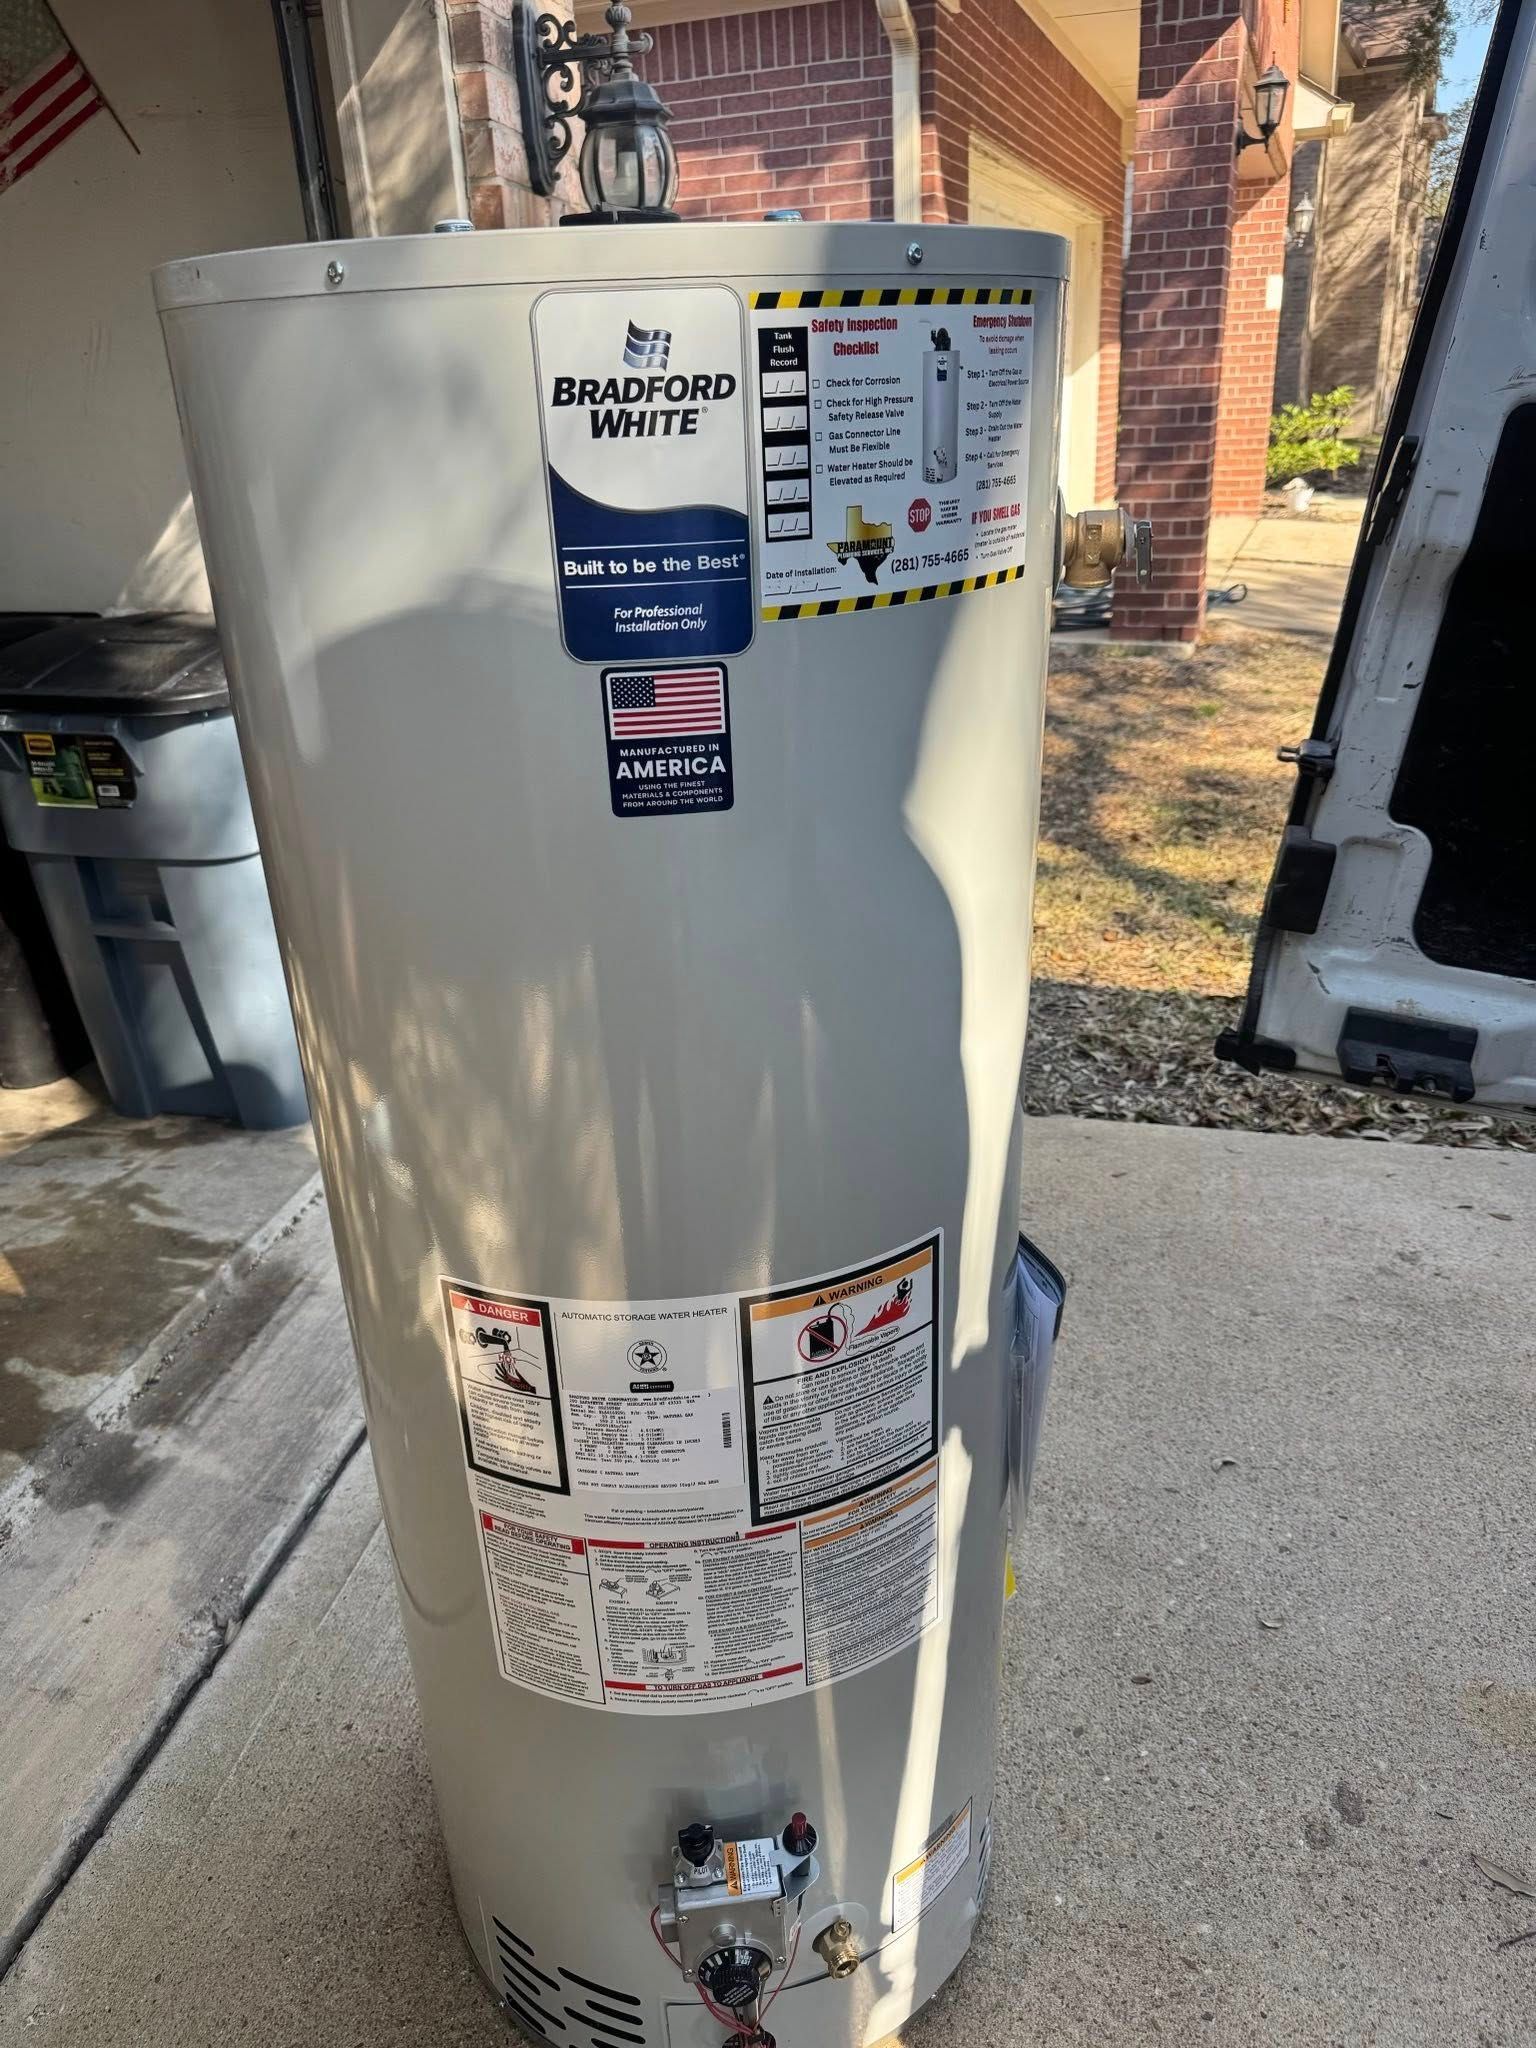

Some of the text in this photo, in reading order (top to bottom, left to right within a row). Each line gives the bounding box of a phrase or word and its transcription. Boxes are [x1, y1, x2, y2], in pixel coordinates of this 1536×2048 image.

[812, 317, 898, 333] Safety Inspection
[973, 315, 1007, 328] Emergency
[774, 332, 792, 340] Tank
[998, 336, 1014, 344] damage
[773, 345, 794, 353] Flush
[834, 341, 879, 356] Checklist
[989, 347, 1004, 356] leaking
[770, 358, 798, 367] Record
[826, 376, 900, 388] Check for Corrosion
[967, 370, 980, 380] Step
[551, 373, 736, 407] BRADFORD
[826, 395, 914, 408] Check for High Pressure
[967, 402, 979, 411] Step
[981, 401, 984, 409] 2
[828, 409, 904, 422] Safety Release Valve
[988, 411, 1002, 419] Supply
[829, 427, 901, 440] Gas Connector Line
[965, 428, 978, 437] Step
[980, 427, 983, 435] 3
[829, 441, 890, 454] Must Be Flexible
[965, 453, 978, 462] Step
[979, 452, 982, 460] 4
[1001, 449, 1020, 457] Emergency
[827, 458, 913, 473] Water Heater Should be
[830, 475, 862, 486] Elevated
[874, 472, 906, 483] Required
[976, 475, 1016, 491] (281) 755-4665
[909, 508, 931, 523] STOP
[971, 504, 1020, 524] IF YOU SMELL GAS
[936, 518, 962, 526] WARRANTY
[838, 537, 892, 553] PARAMOUNT
[563, 560, 604, 576] Built
[609, 560, 628, 574] to
[633, 558, 656, 573] be
[662, 557, 692, 572] the
[891, 549, 969, 574] (281) 755-4665
[766, 567, 837, 580] Date of Installation:
[614, 603, 703, 619] For Professional
[615, 618, 707, 633] Installation Only
[620, 745, 706, 756] MANUFACTURED
[616, 756, 726, 779] AMERICA
[680, 780, 705, 788] FINEST
[622, 792, 663, 800] MATERIALS
[672, 788, 723, 796] COMPONENTS
[828, 1275, 883, 1301] WARNING
[479, 1304, 528, 1322] DANGER
[562, 1307, 727, 1322] AUTOMATIC STORAGE WATER HEATER
[848, 1327, 899, 1350] Flammable Vapors
[797, 1346, 896, 1384] FIRE AND EXPLOSION HAZARD
[814, 1377, 830, 1385] result
[857, 1363, 871, 1372] injury
[494, 1525, 571, 1550] READ BEFORE OPERATING
[504, 1522, 558, 1542] FOR YOUR SAFETY
[724, 1676, 759, 1686] APPLIANCE
[727, 1848, 737, 1881] WARNING
